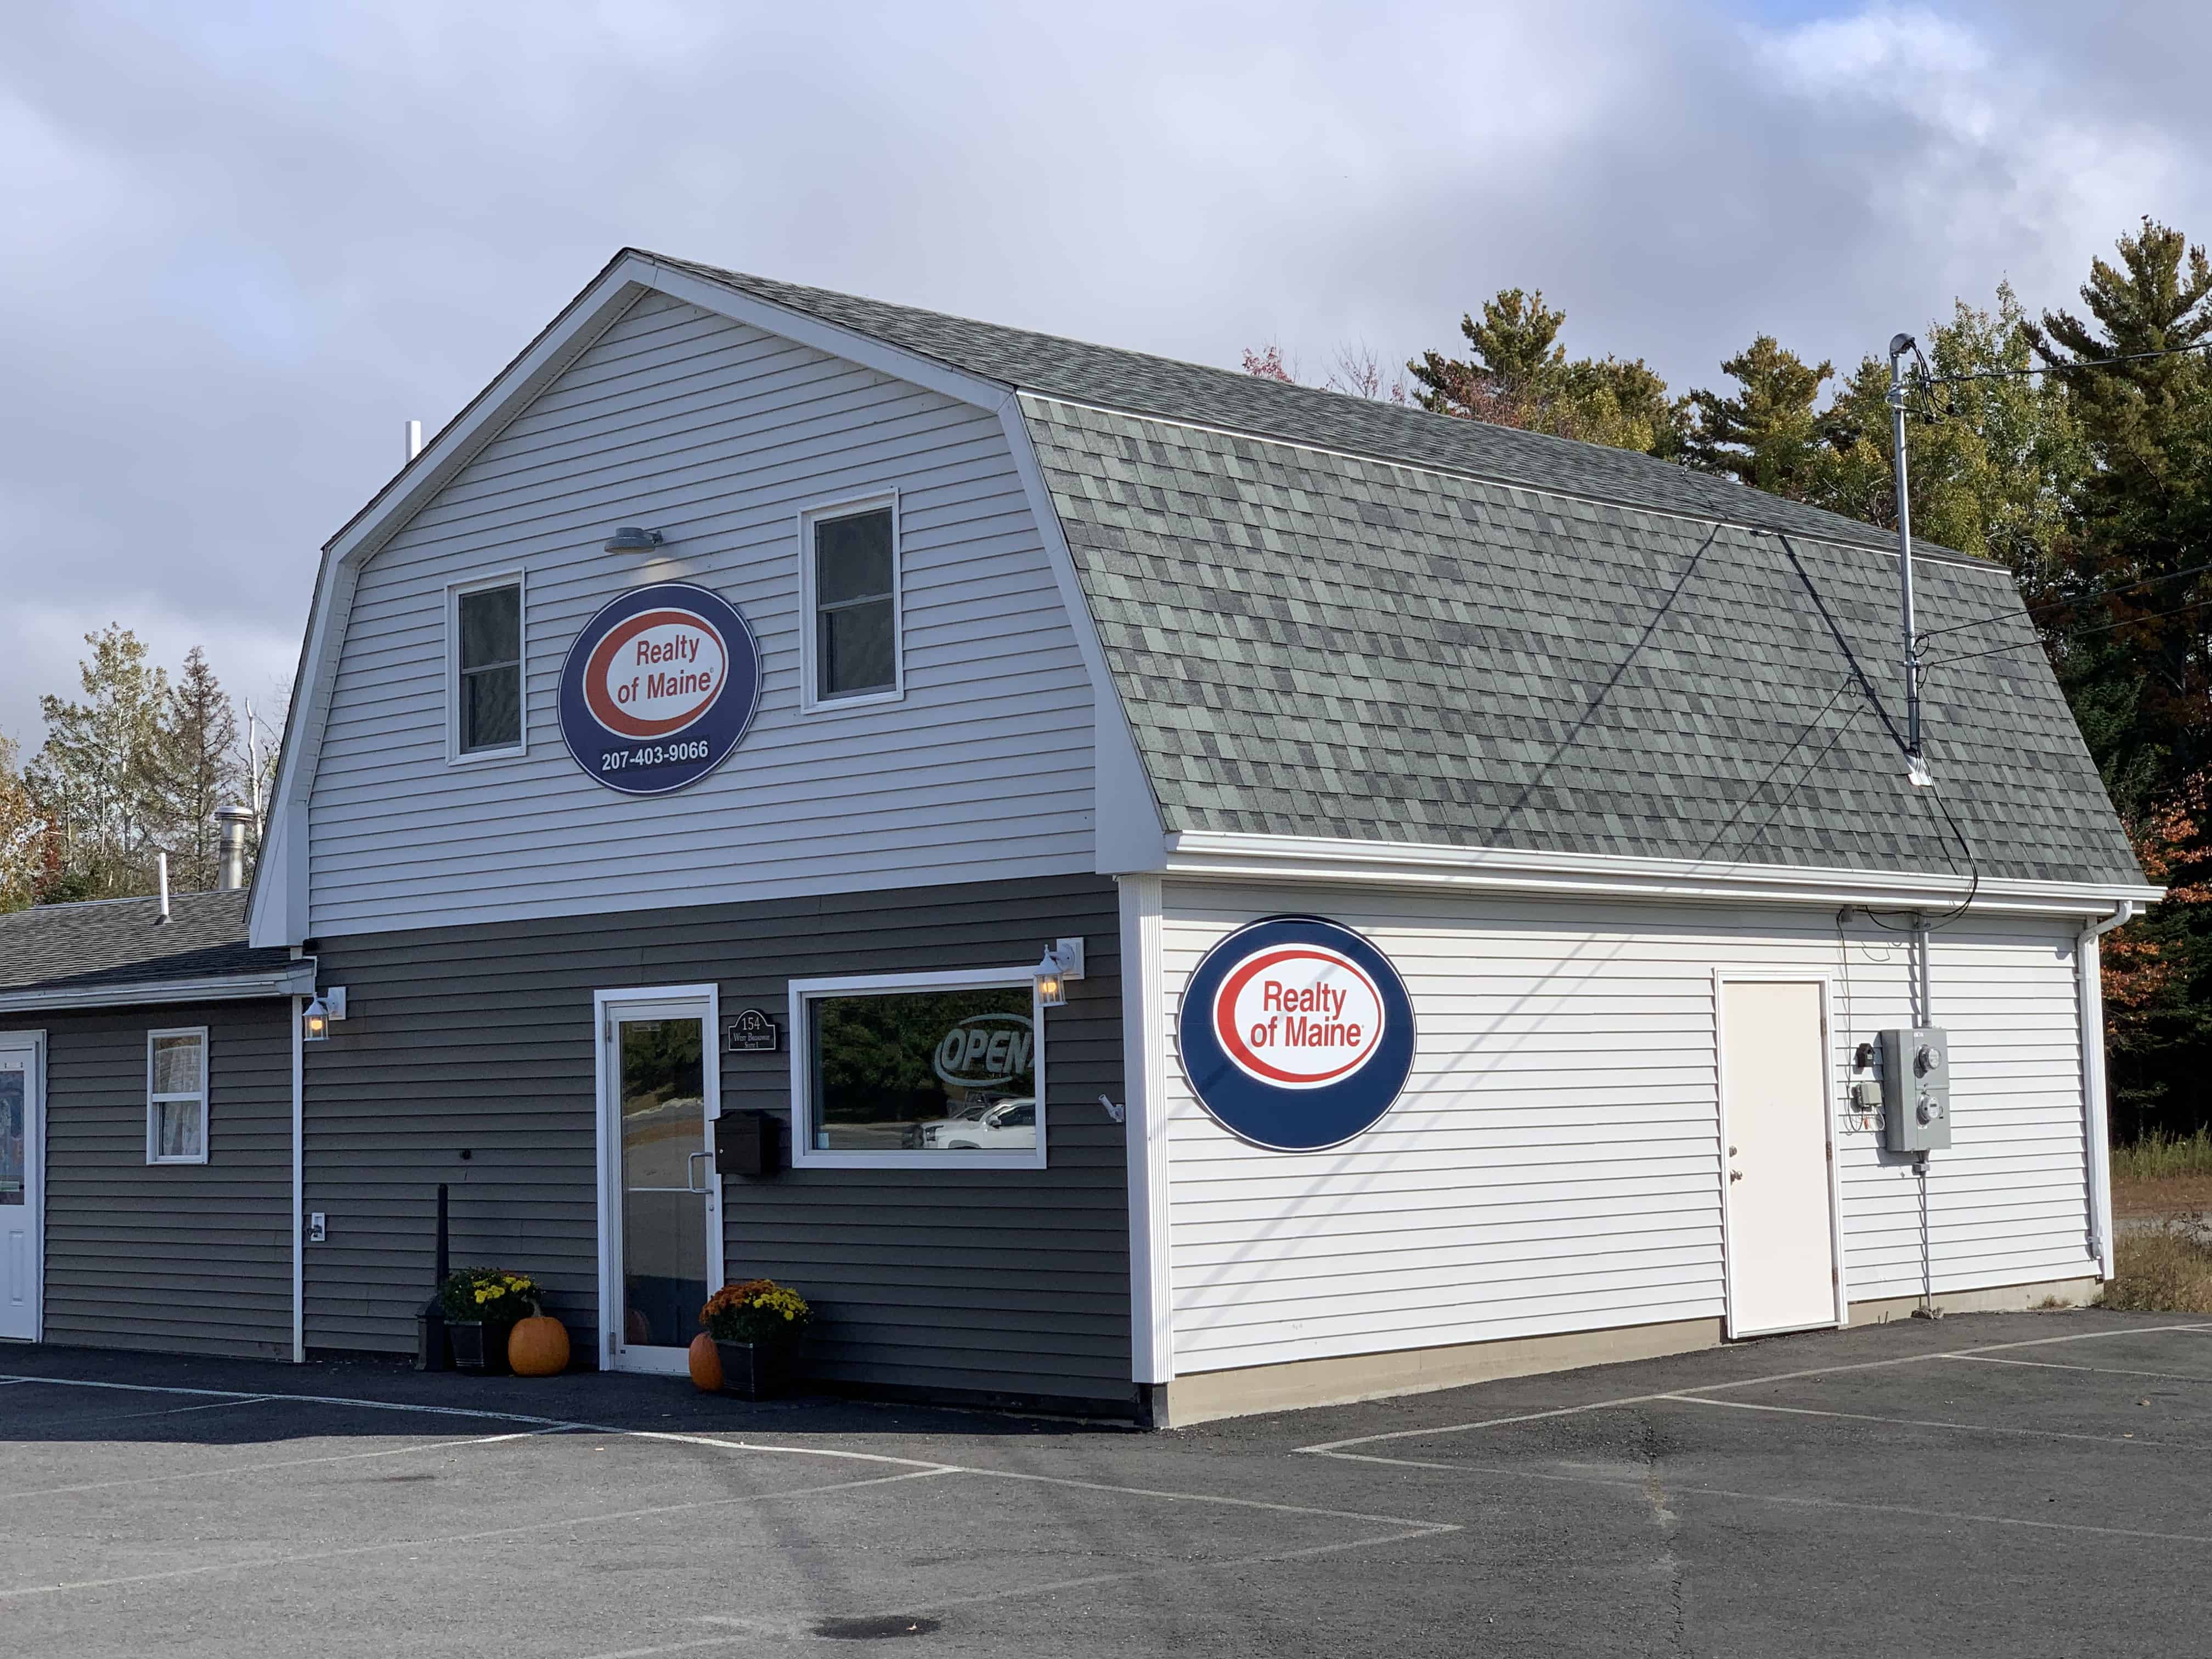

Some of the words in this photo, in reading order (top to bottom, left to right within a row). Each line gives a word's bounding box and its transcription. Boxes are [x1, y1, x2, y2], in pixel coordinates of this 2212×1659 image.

[636, 635, 699, 665] Realty
[618, 677, 639, 703] of
[647, 670, 711, 699] Maine
[602, 741, 708, 771] 207-403-9066
[1263, 981, 1346, 1020] Realty
[742, 1017, 760, 1030] 154
[1250, 1017, 1278, 1047] of
[1285, 1017, 1361, 1047] Maine
[941, 1028, 1032, 1074] OPEN
